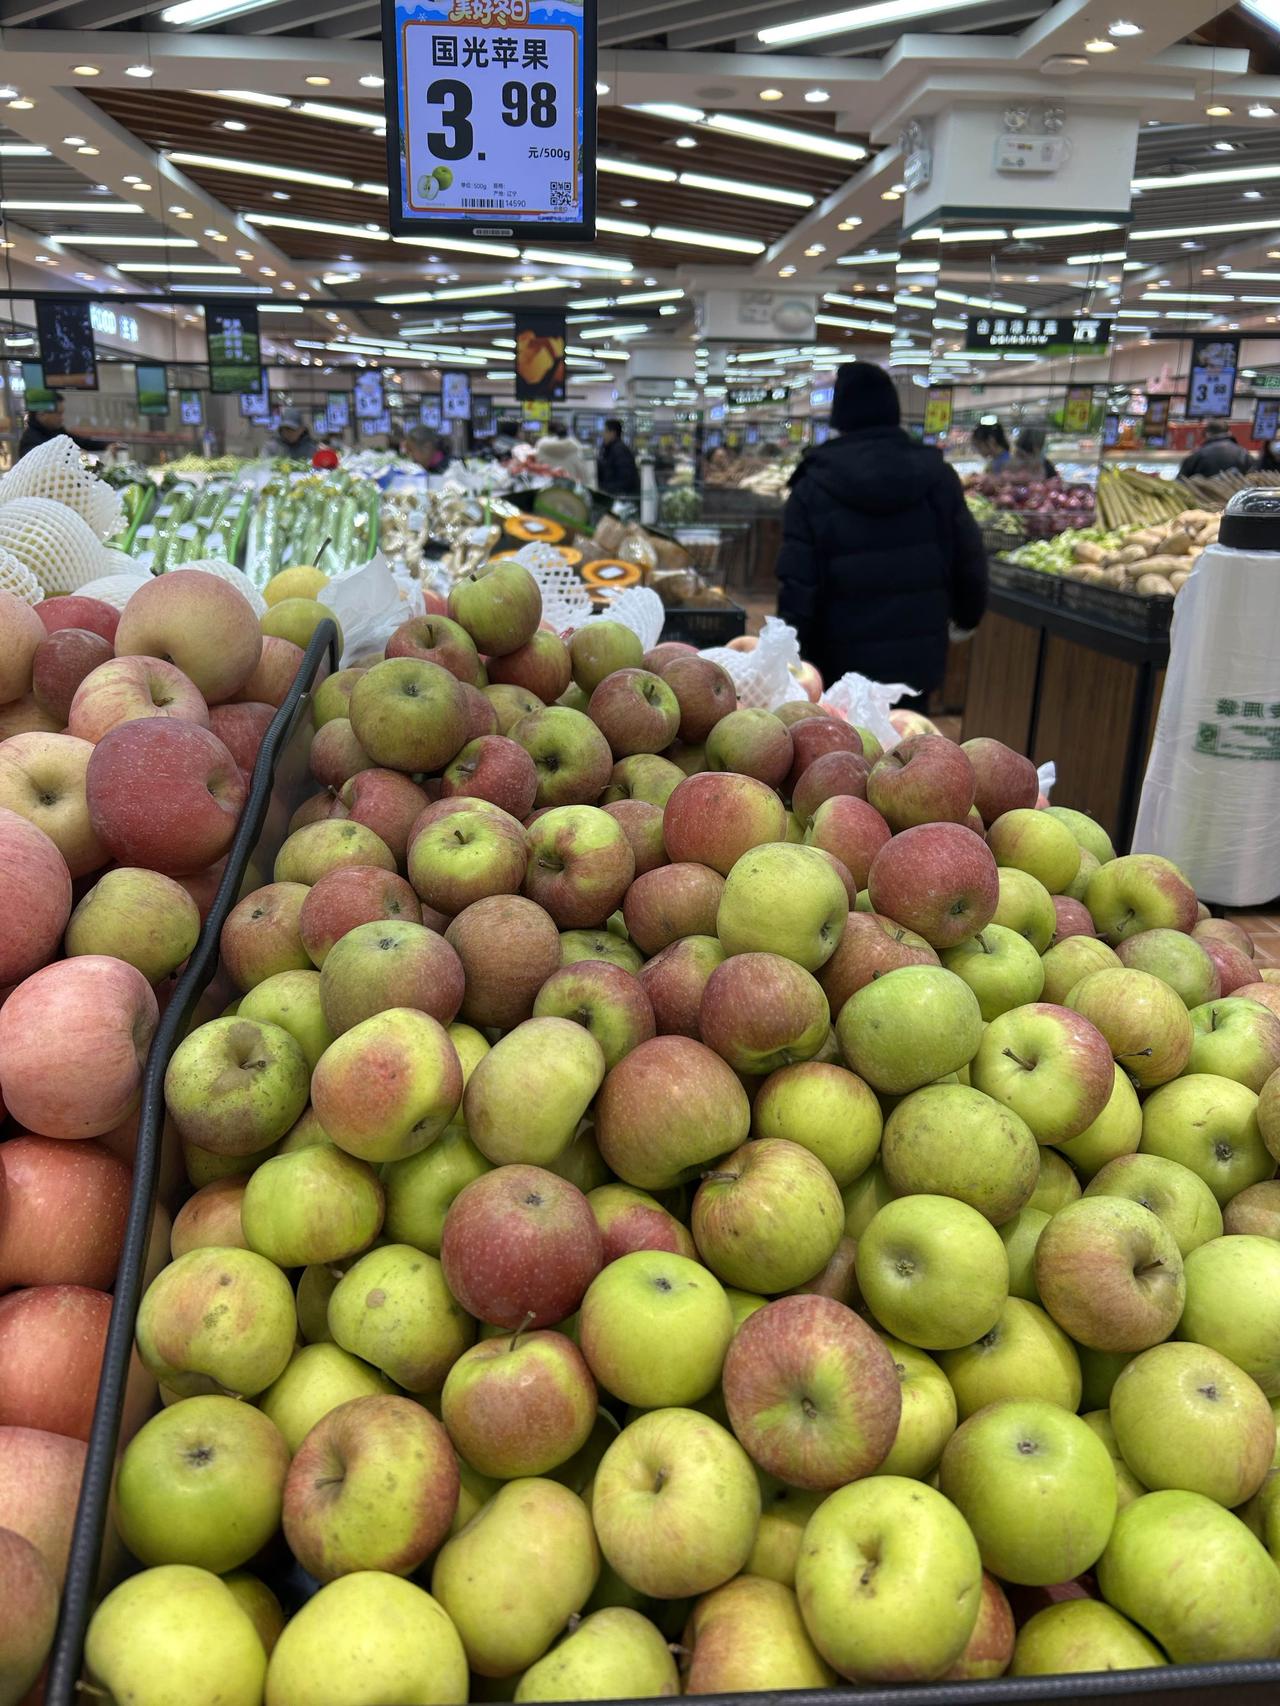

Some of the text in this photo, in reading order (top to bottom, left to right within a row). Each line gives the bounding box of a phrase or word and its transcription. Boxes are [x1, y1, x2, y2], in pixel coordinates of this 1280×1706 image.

[432, 36, 549, 70] 国光苹果
[527, 146, 571, 161] 元/500g
[505, 199, 526, 208] 14590
